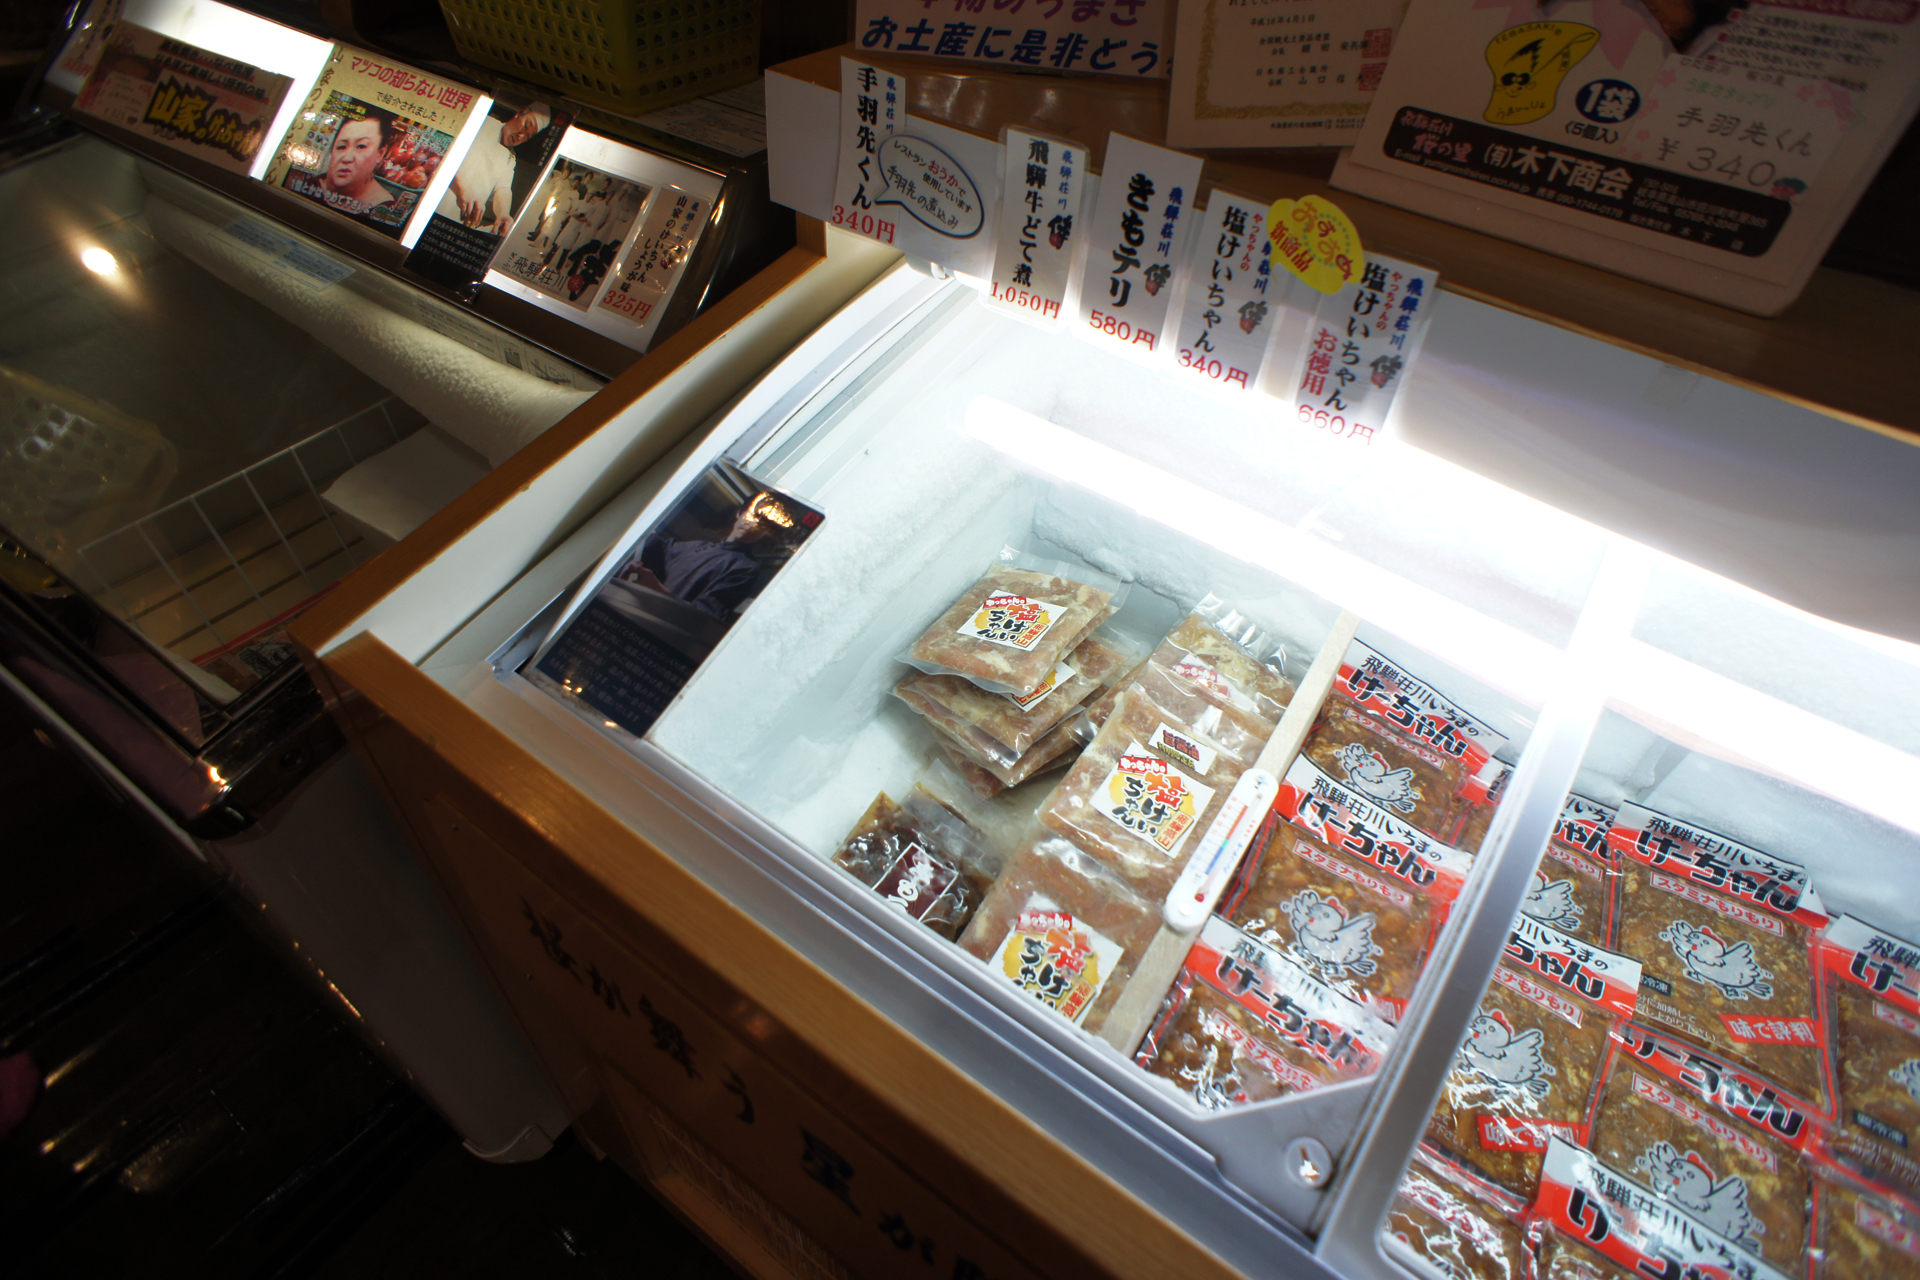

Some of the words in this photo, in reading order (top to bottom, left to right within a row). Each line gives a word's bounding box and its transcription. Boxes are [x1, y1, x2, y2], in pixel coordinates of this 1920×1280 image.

[861, 16, 1171, 76] お土産に是非どう
[351, 55, 474, 114] マツコの知らない世界
[1581, 82, 1638, 122] 1袋
[851, 66, 879, 212] 手羽先くん
[1676, 106, 1815, 158] 手羽先くん
[637, 195, 688, 284] 山家のけいちゃん
[831, 204, 896, 245] 340円
[1011, 137, 1051, 288] 飛騨牛どて煮
[1108, 171, 1156, 309] きもテリ
[1291, 202, 1354, 281] おすすめ
[619, 237, 651, 294] しょうが味
[1240, 213, 1264, 272] やっちゃんの
[1269, 220, 1316, 274] 新商品
[603, 289, 653, 320] 325円
[989, 280, 1062, 321] 1,050円
[1192, 204, 1249, 353] 塩けいちゃん
[1375, 271, 1404, 331] やっちゃんの
[1089, 308, 1158, 351] 580円
[1323, 261, 1391, 412] 塩けいちゃん
[1178, 348, 1249, 390] 340円
[1300, 327, 1339, 397] お徳用
[1298, 403, 1375, 447] 660円
[1347, 667, 1469, 759] けーちゃん
[1361, 654, 1480, 738] 飛騨荘川いちまの
[1156, 812, 1191, 848] 飛騨高山
[1297, 791, 1438, 888] けーちゃん
[1311, 774, 1443, 863] 飛騨荘川いちまの
[1299, 844, 1405, 903] スタミナもりもり
[1635, 829, 1800, 913] けーちゃん
[1656, 874, 1777, 933] スタミナもりもり
[1504, 932, 1606, 1001] ちゃん
[1514, 916, 1609, 971] 川いちまの
[1060, 981, 1092, 1018] 飛騨高
[1639, 1079, 1771, 1164] スタミナもりもり
